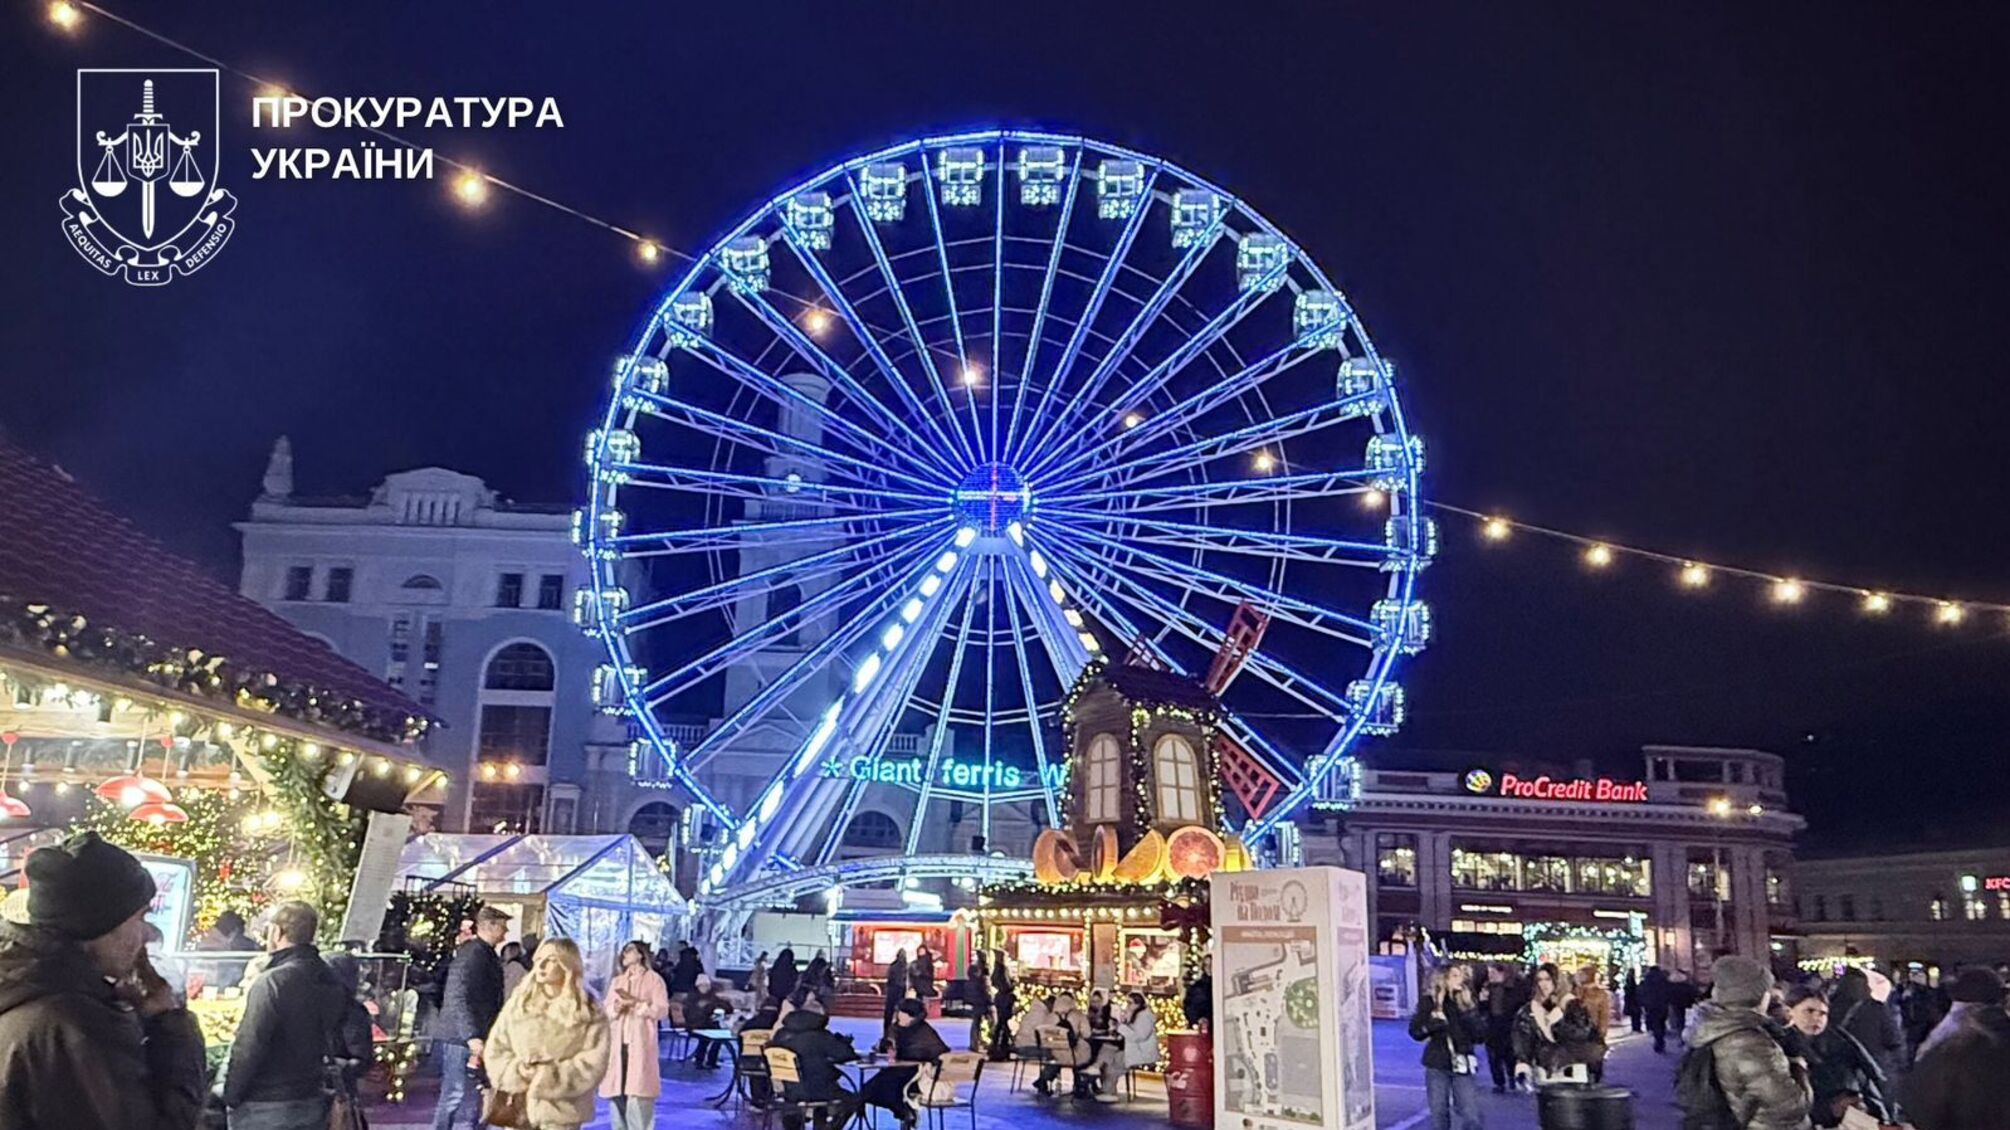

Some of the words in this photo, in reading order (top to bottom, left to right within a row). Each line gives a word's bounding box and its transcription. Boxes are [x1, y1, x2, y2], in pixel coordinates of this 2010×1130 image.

[850, 755, 922, 783] Giant
[942, 758, 1021, 787] ferris
[1501, 773, 1593, 799] ProCredit
[1596, 779, 1648, 801] Bank
